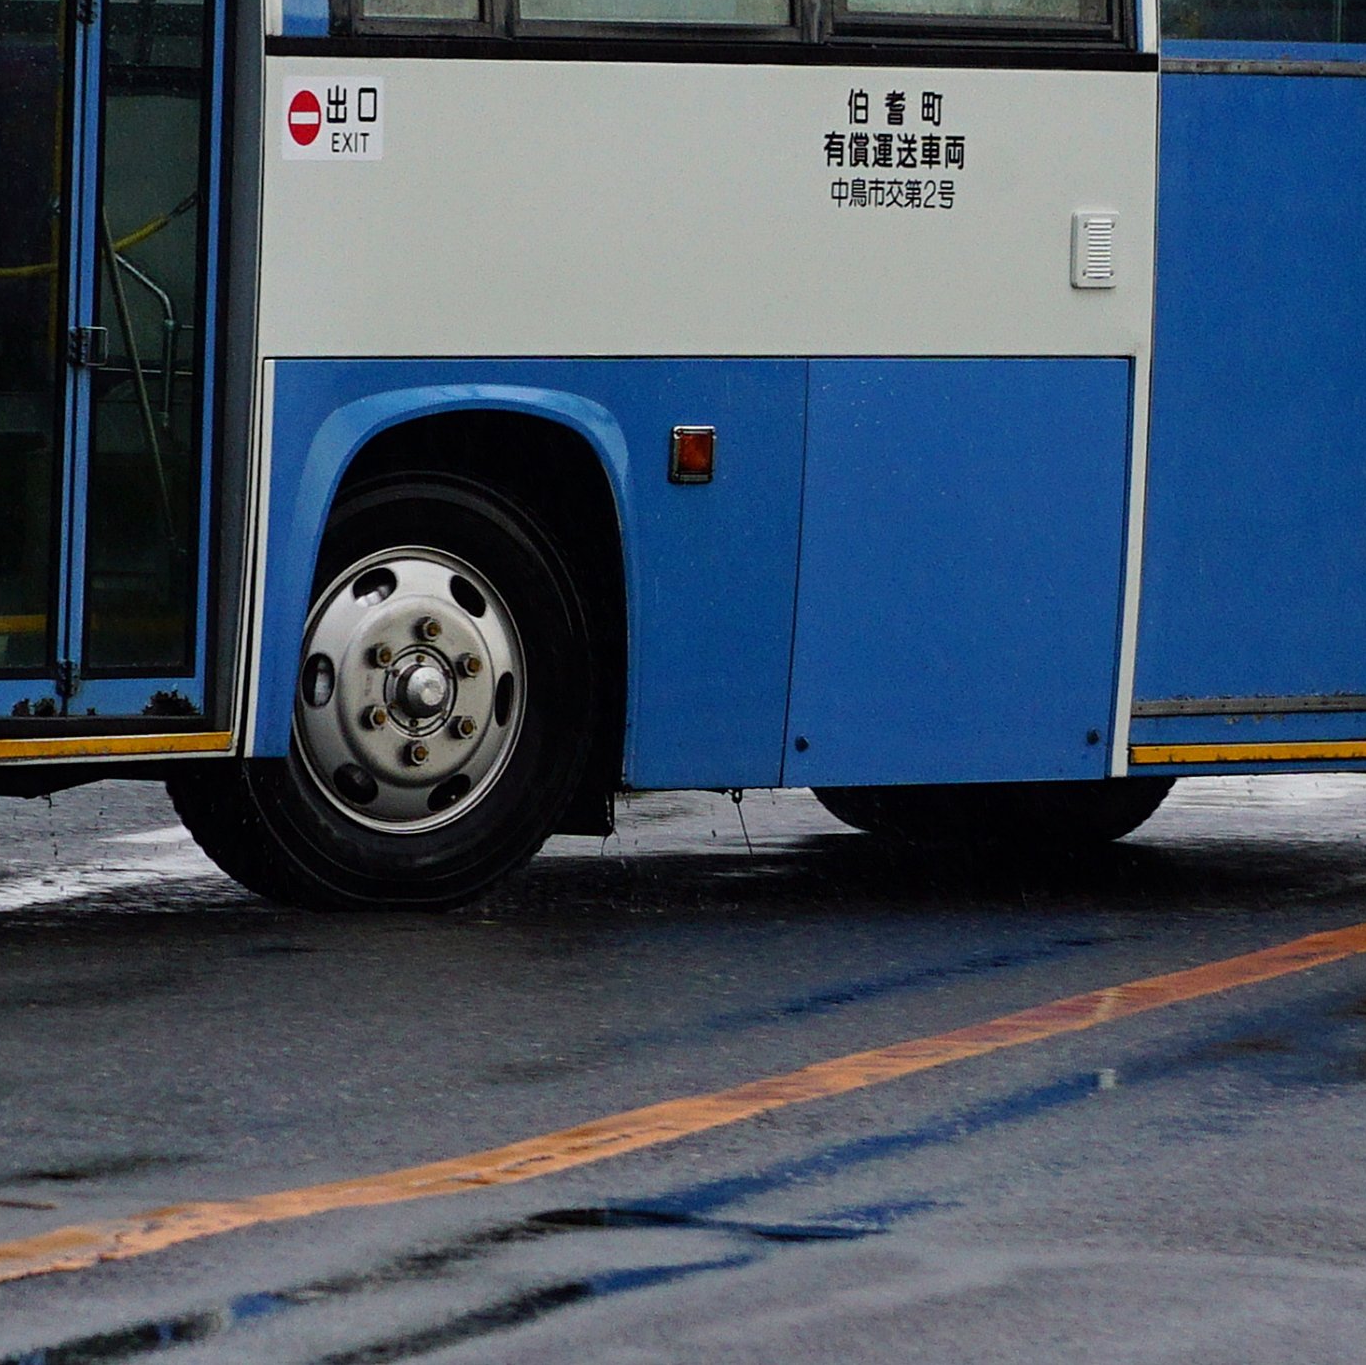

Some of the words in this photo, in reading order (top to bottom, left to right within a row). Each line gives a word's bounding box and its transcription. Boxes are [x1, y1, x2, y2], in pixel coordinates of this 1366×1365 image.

[326, 84, 377, 124] 出口
[848, 88, 943, 126] 伯耆町
[331, 132, 370, 153] EXIT
[823, 130, 966, 170] 有償運送車両
[831, 177, 956, 209] 中鳥市交第2号
